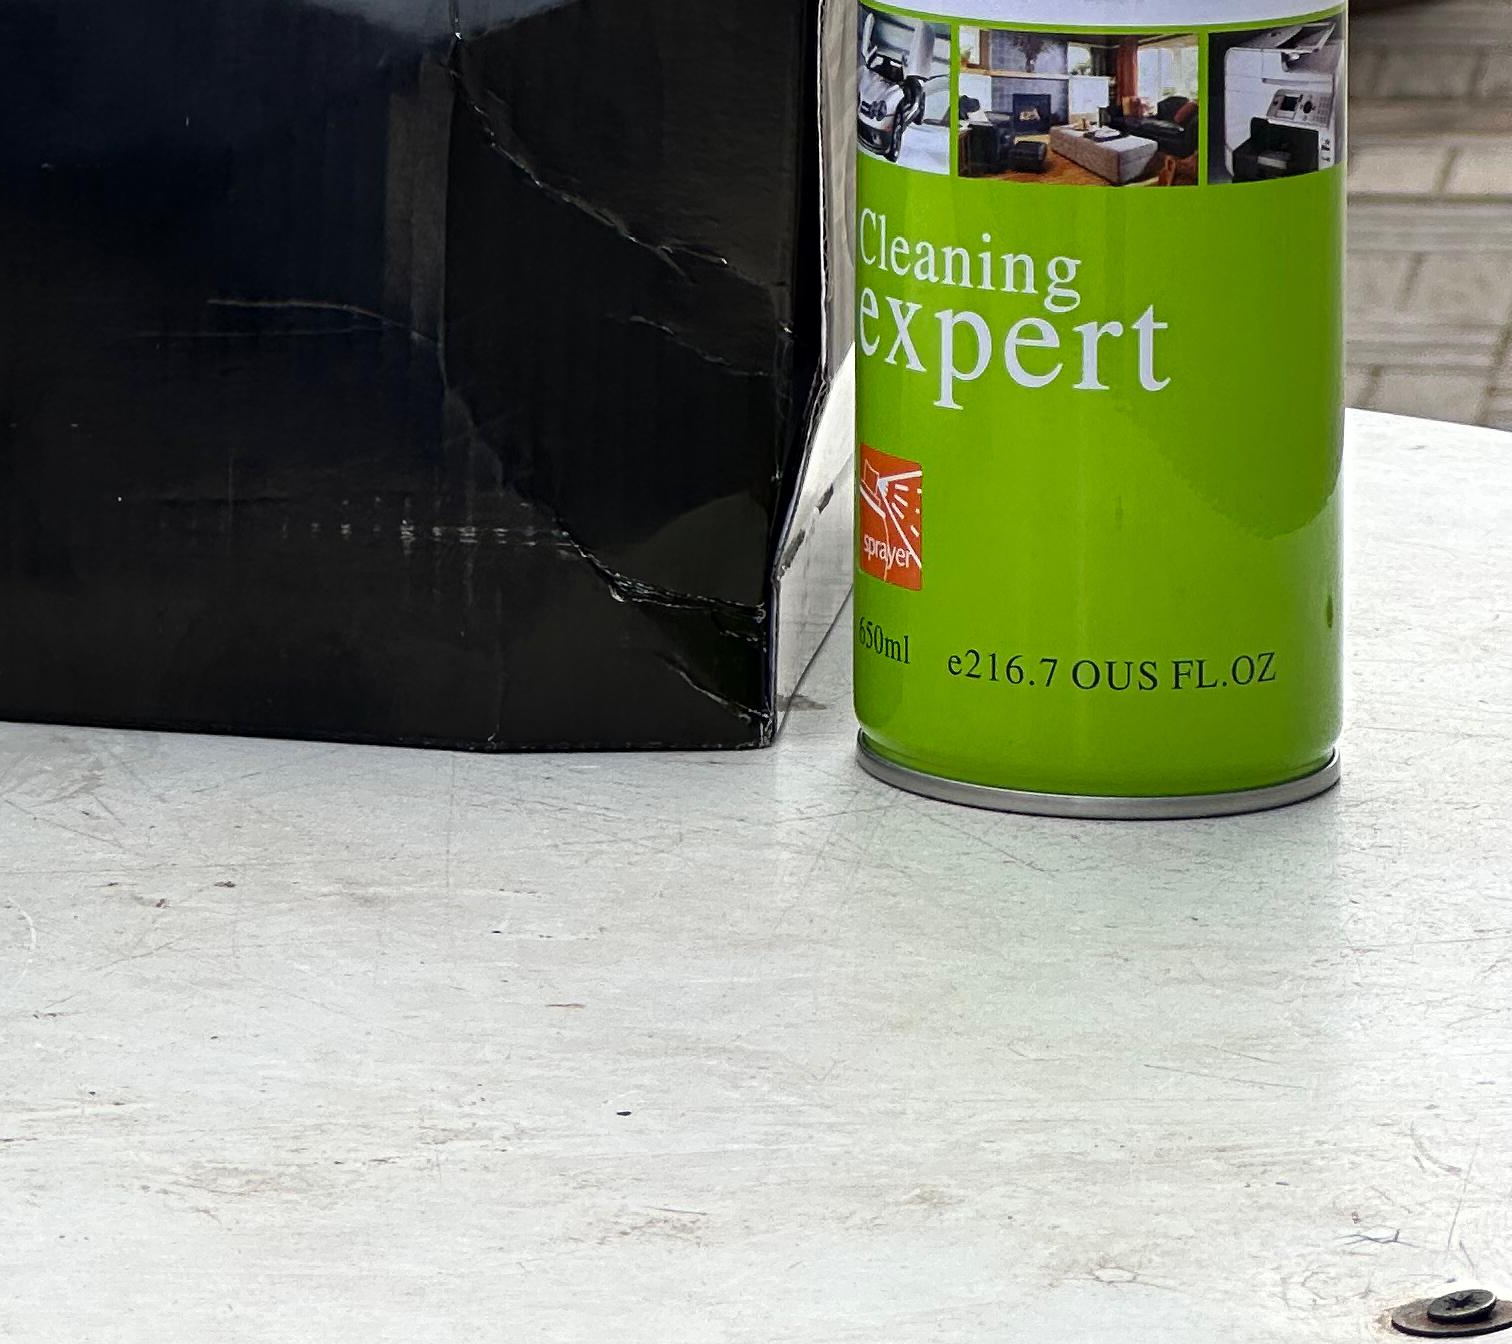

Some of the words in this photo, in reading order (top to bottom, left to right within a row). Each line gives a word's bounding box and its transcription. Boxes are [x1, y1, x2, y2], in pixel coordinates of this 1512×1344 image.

[859, 207, 1083, 312] Cleaning
[858, 285, 1172, 410] expert
[862, 533, 912, 570] sprayer
[859, 616, 911, 665] 650ml
[947, 647, 1060, 688] e216.7
[1071, 659, 1159, 691] OUS
[1170, 650, 1278, 691] FL.OZ
